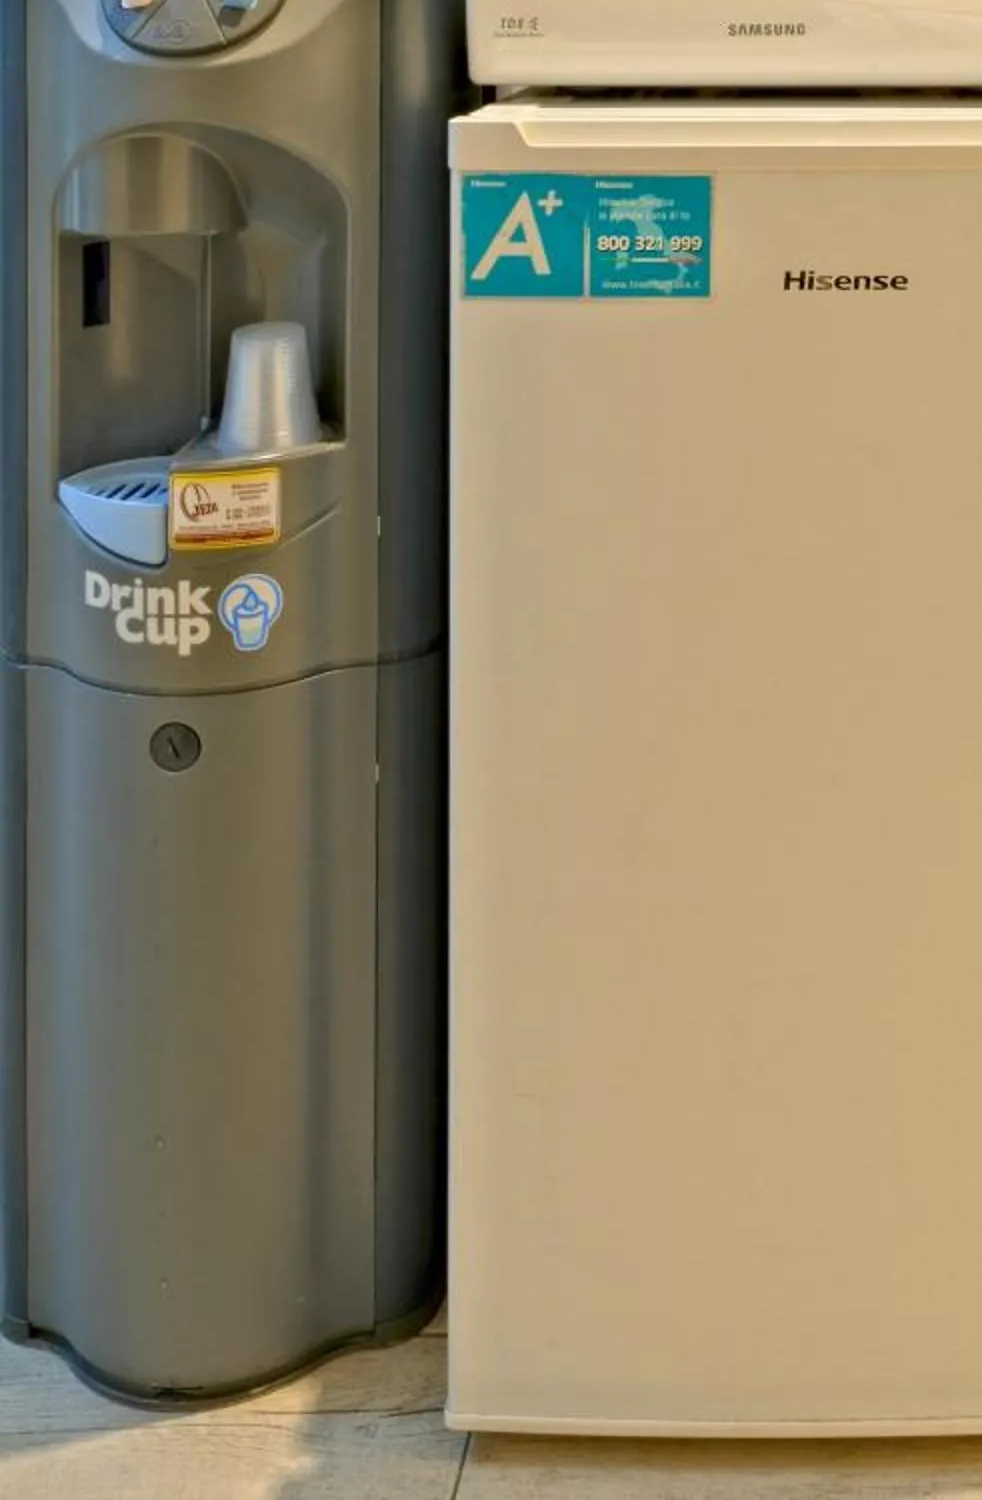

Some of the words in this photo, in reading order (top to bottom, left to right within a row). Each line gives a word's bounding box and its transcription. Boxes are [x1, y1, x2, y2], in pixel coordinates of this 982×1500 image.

[727, 22, 807, 37] SAMSUNG
[597, 235, 630, 251] 800
[635, 235, 664, 251] 321
[670, 235, 703, 251] 999
[783, 269, 909, 292] Hisense
[84, 569, 213, 616] Drink
[114, 605, 212, 657] Cup
